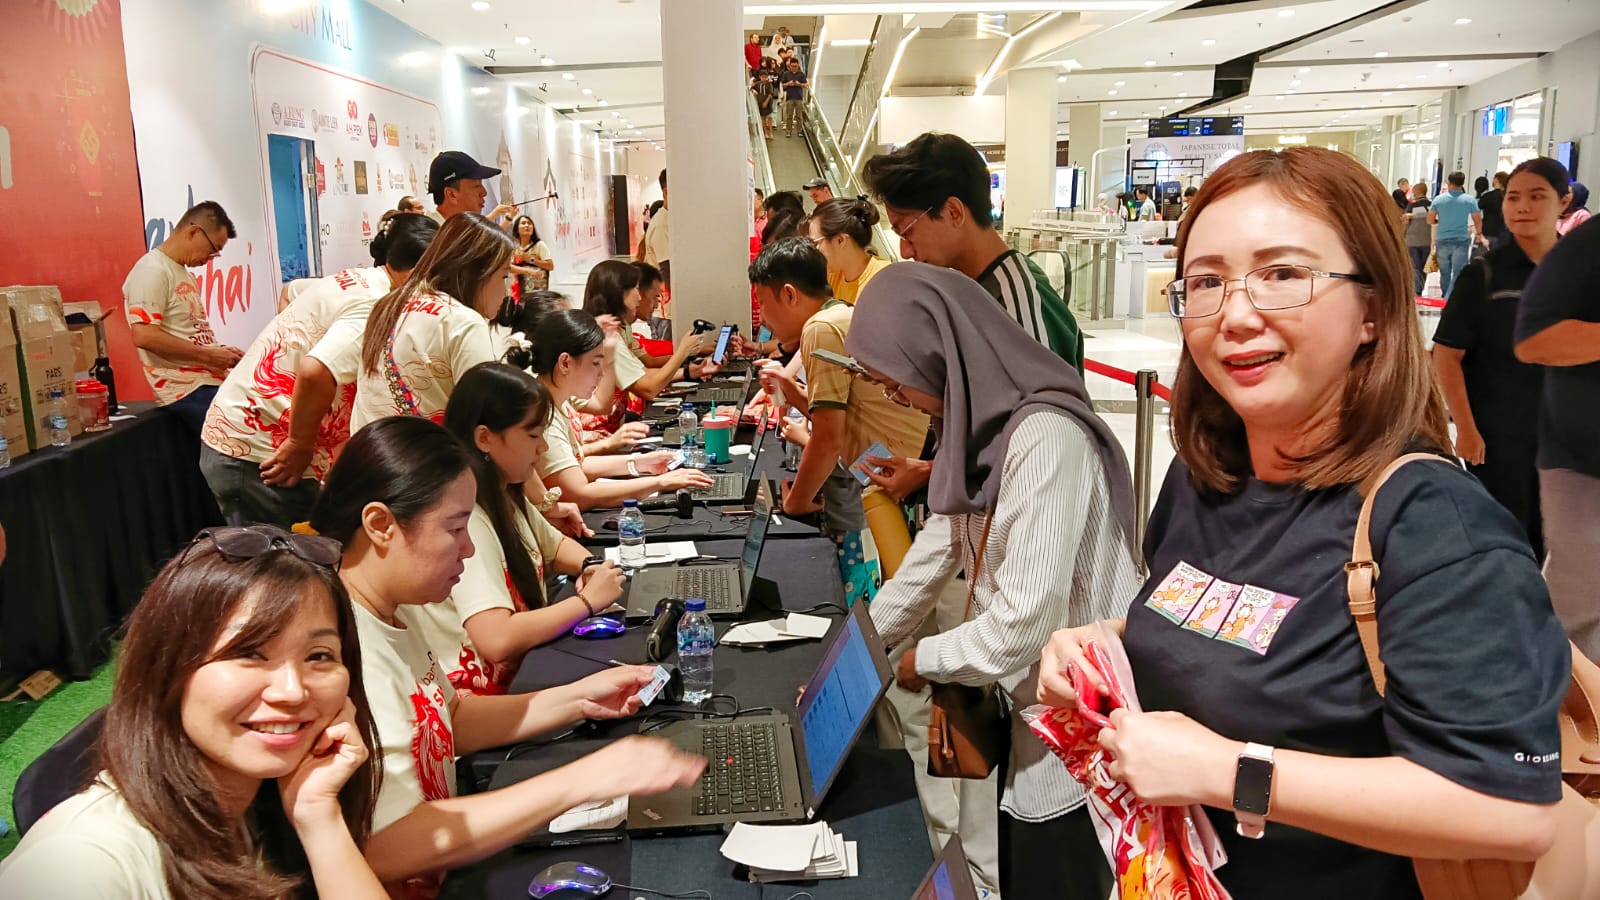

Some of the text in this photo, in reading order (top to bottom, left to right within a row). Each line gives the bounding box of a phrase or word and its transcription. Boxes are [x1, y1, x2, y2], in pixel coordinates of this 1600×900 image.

[321, 6, 352, 51] MALL
[1181, 142, 1240, 151] JAPANESE TOTAL
[401, 300, 444, 317] ICIAL
